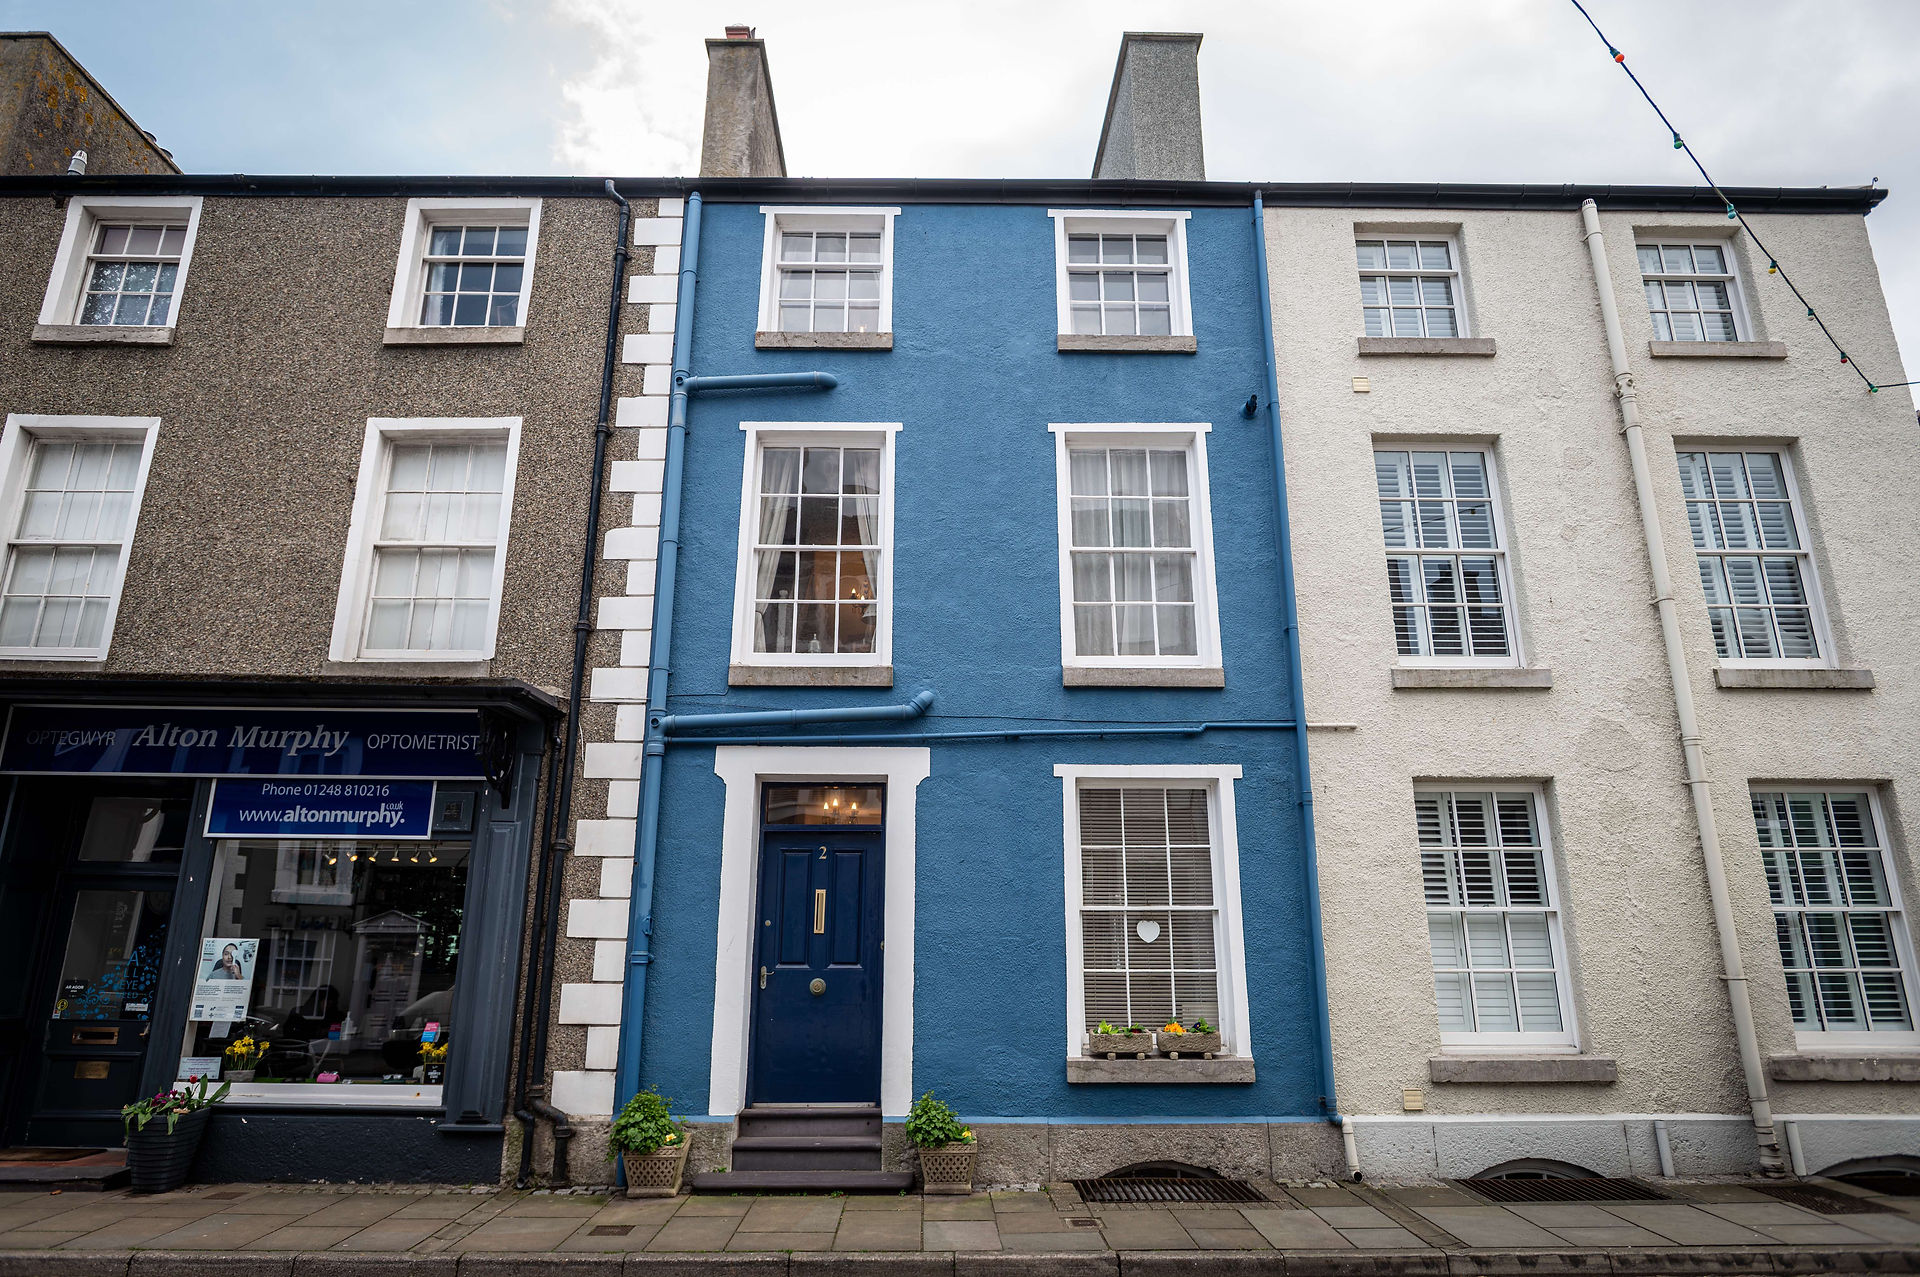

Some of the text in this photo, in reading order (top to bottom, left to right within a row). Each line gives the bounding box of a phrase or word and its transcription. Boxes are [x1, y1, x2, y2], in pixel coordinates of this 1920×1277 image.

[26, 723, 480, 757] OPTEGWYR Alton Murphy OPTOMETRIST
[261, 783, 390, 797] Phone 01248 810216
[818, 846, 827, 860] 2
[127, 951, 139, 966] A
[119, 980, 139, 990] EYE
